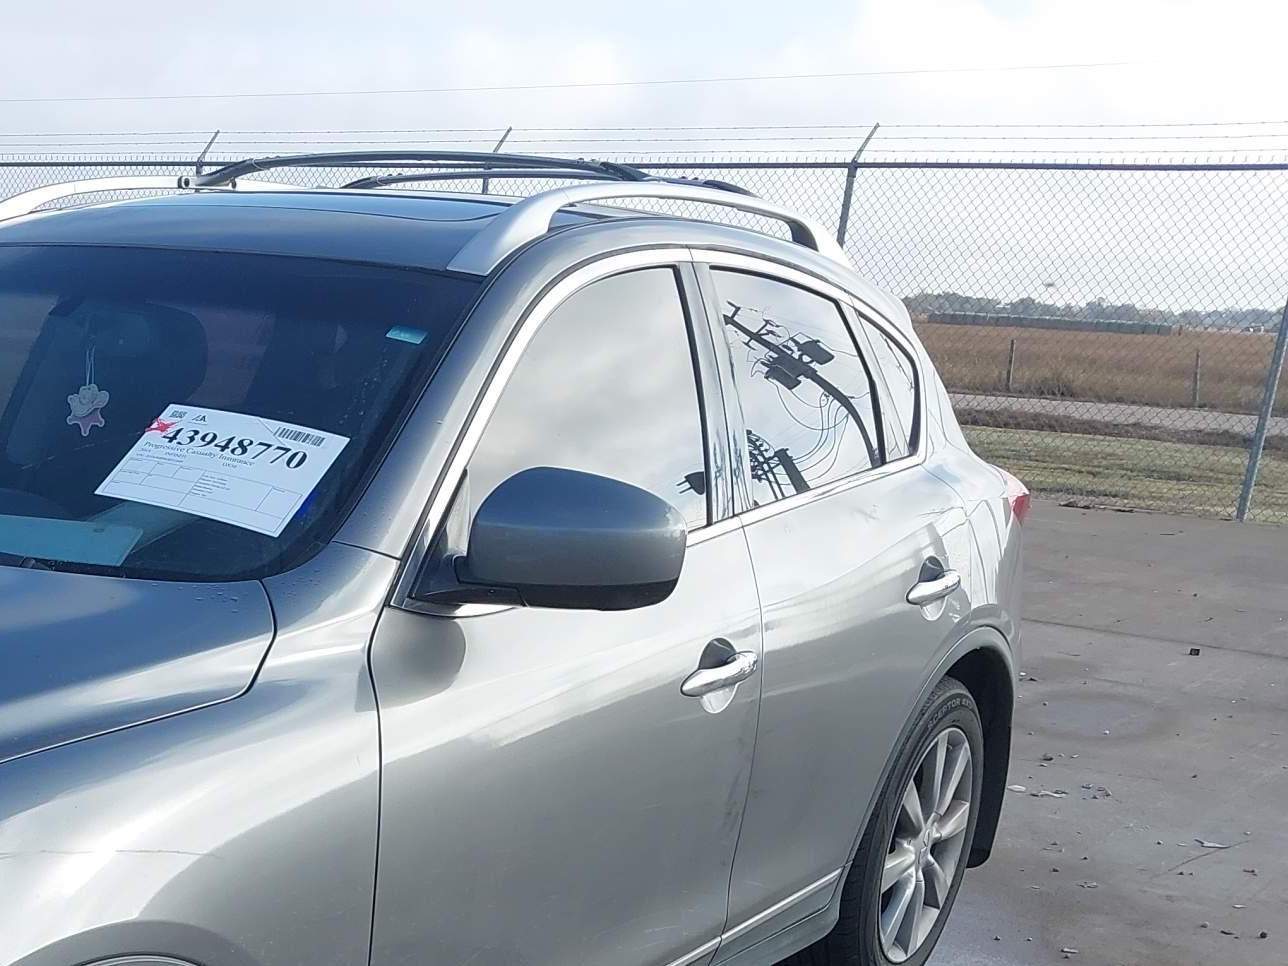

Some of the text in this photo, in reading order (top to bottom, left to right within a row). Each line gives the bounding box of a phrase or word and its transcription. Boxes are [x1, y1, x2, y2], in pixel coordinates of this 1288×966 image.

[143, 441, 185, 454] Progressive
[186, 447, 217, 459] Casualty
[162, 427, 308, 469] 43948770
